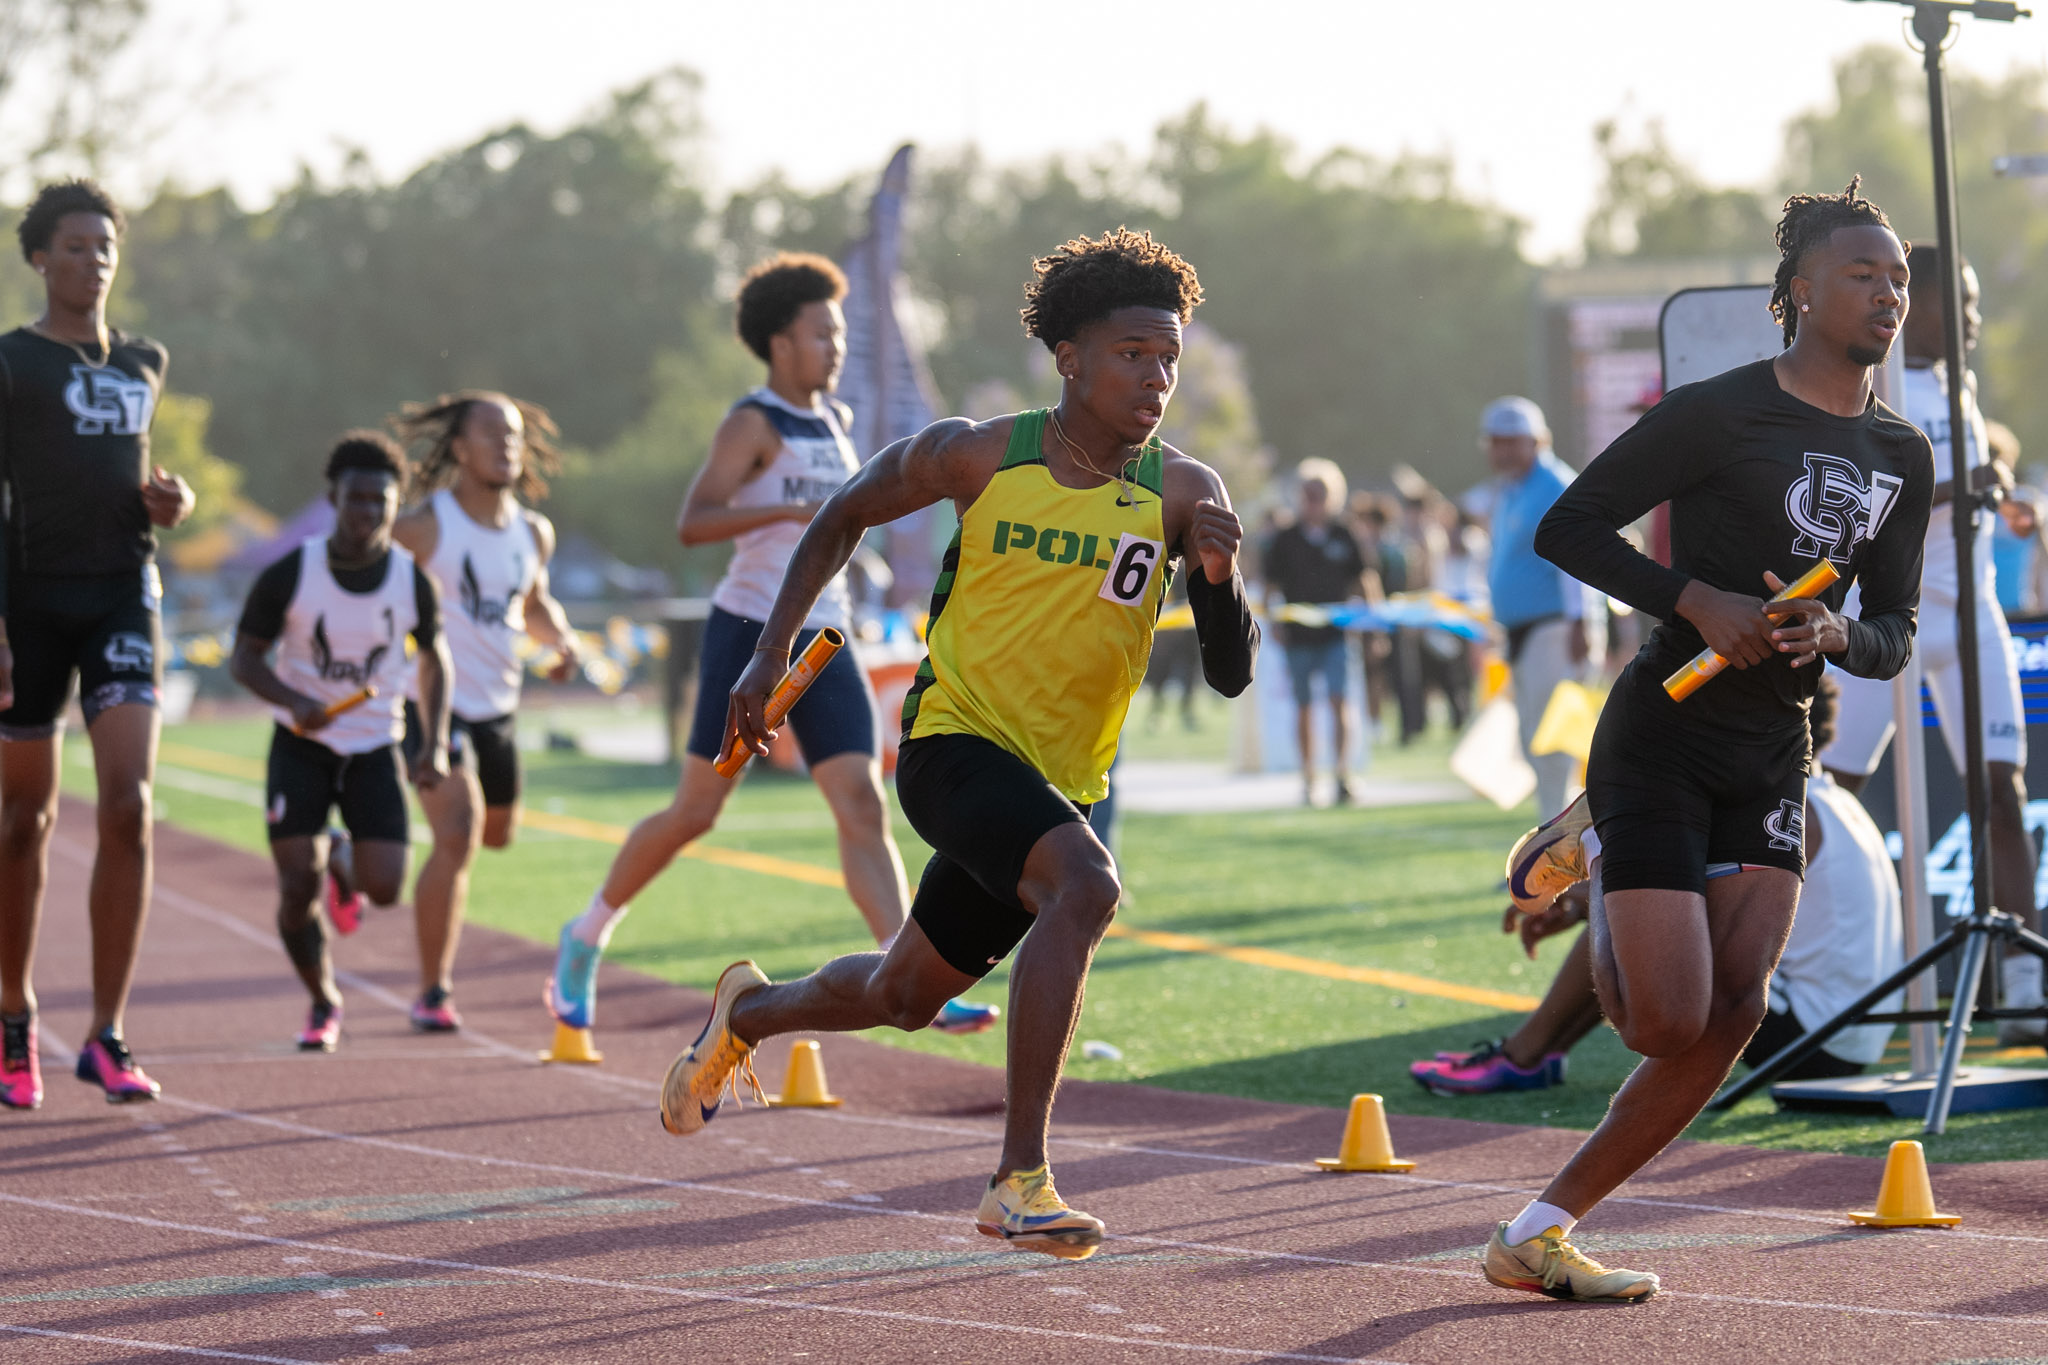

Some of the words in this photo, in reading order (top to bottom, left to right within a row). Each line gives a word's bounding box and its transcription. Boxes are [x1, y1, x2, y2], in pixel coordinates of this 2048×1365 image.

[1873, 478, 1900, 536] 7
[992, 520, 1120, 570] POL
[1112, 542, 1155, 600] 6
